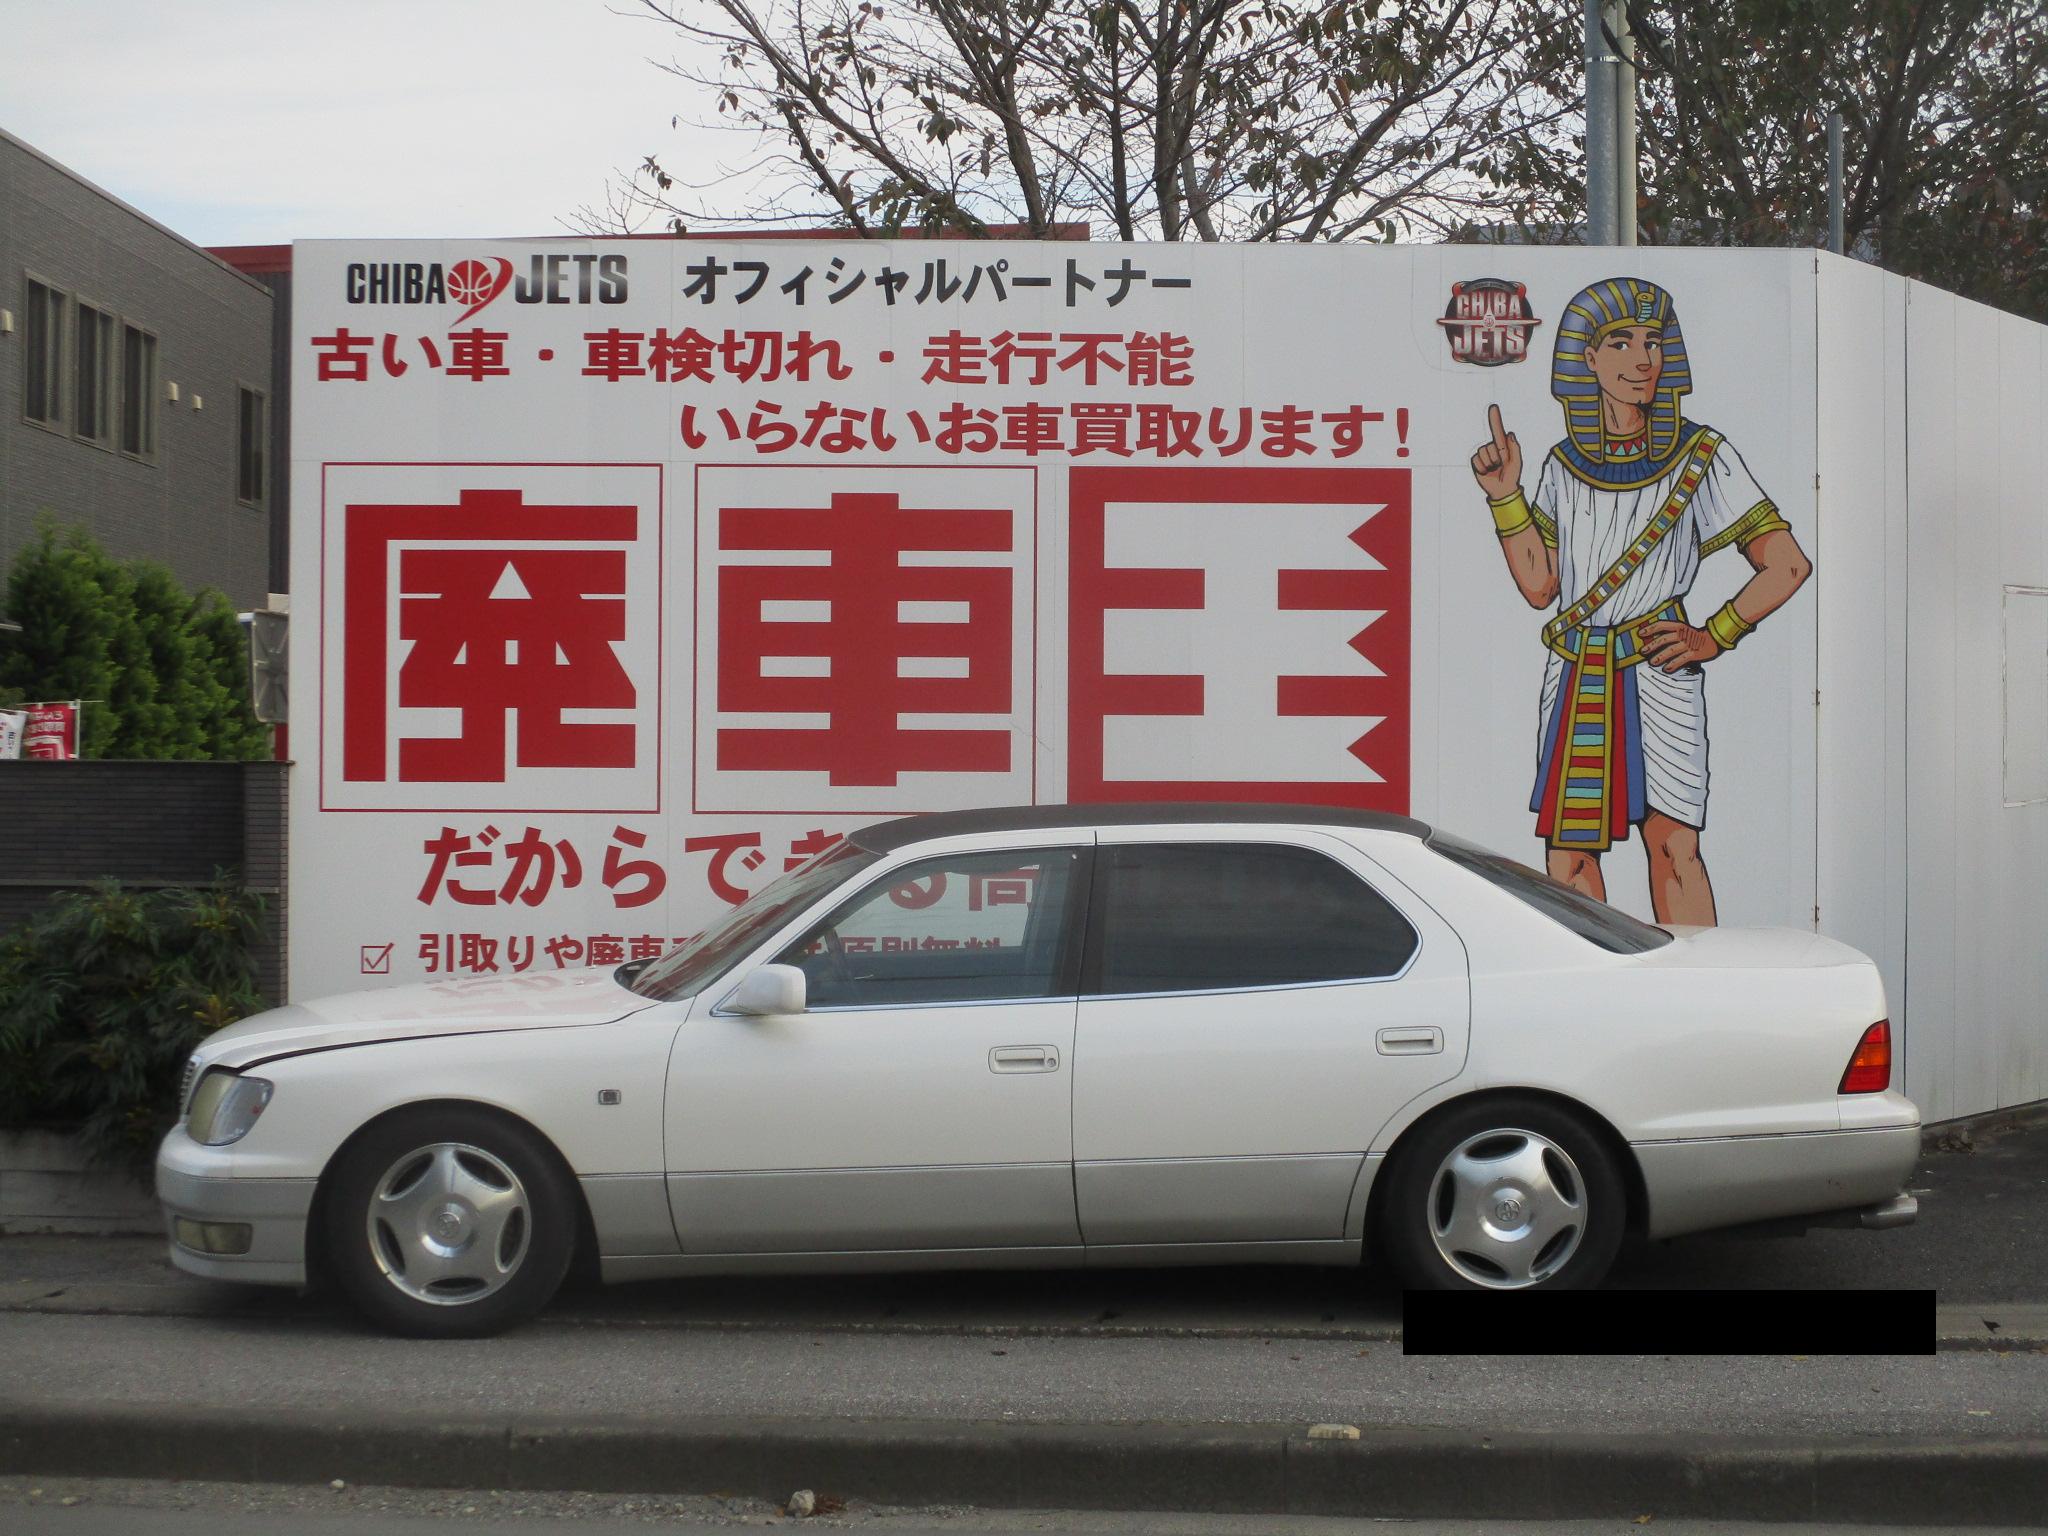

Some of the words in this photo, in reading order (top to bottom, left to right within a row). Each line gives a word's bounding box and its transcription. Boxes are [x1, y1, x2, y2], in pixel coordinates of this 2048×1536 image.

[346, 262, 447, 304] CHIBA
[514, 254, 628, 304] JETS
[682, 255, 1192, 307] オフィシャルパートナー
[1456, 289, 1522, 319] CHIBA
[1454, 324, 1526, 358] JETS
